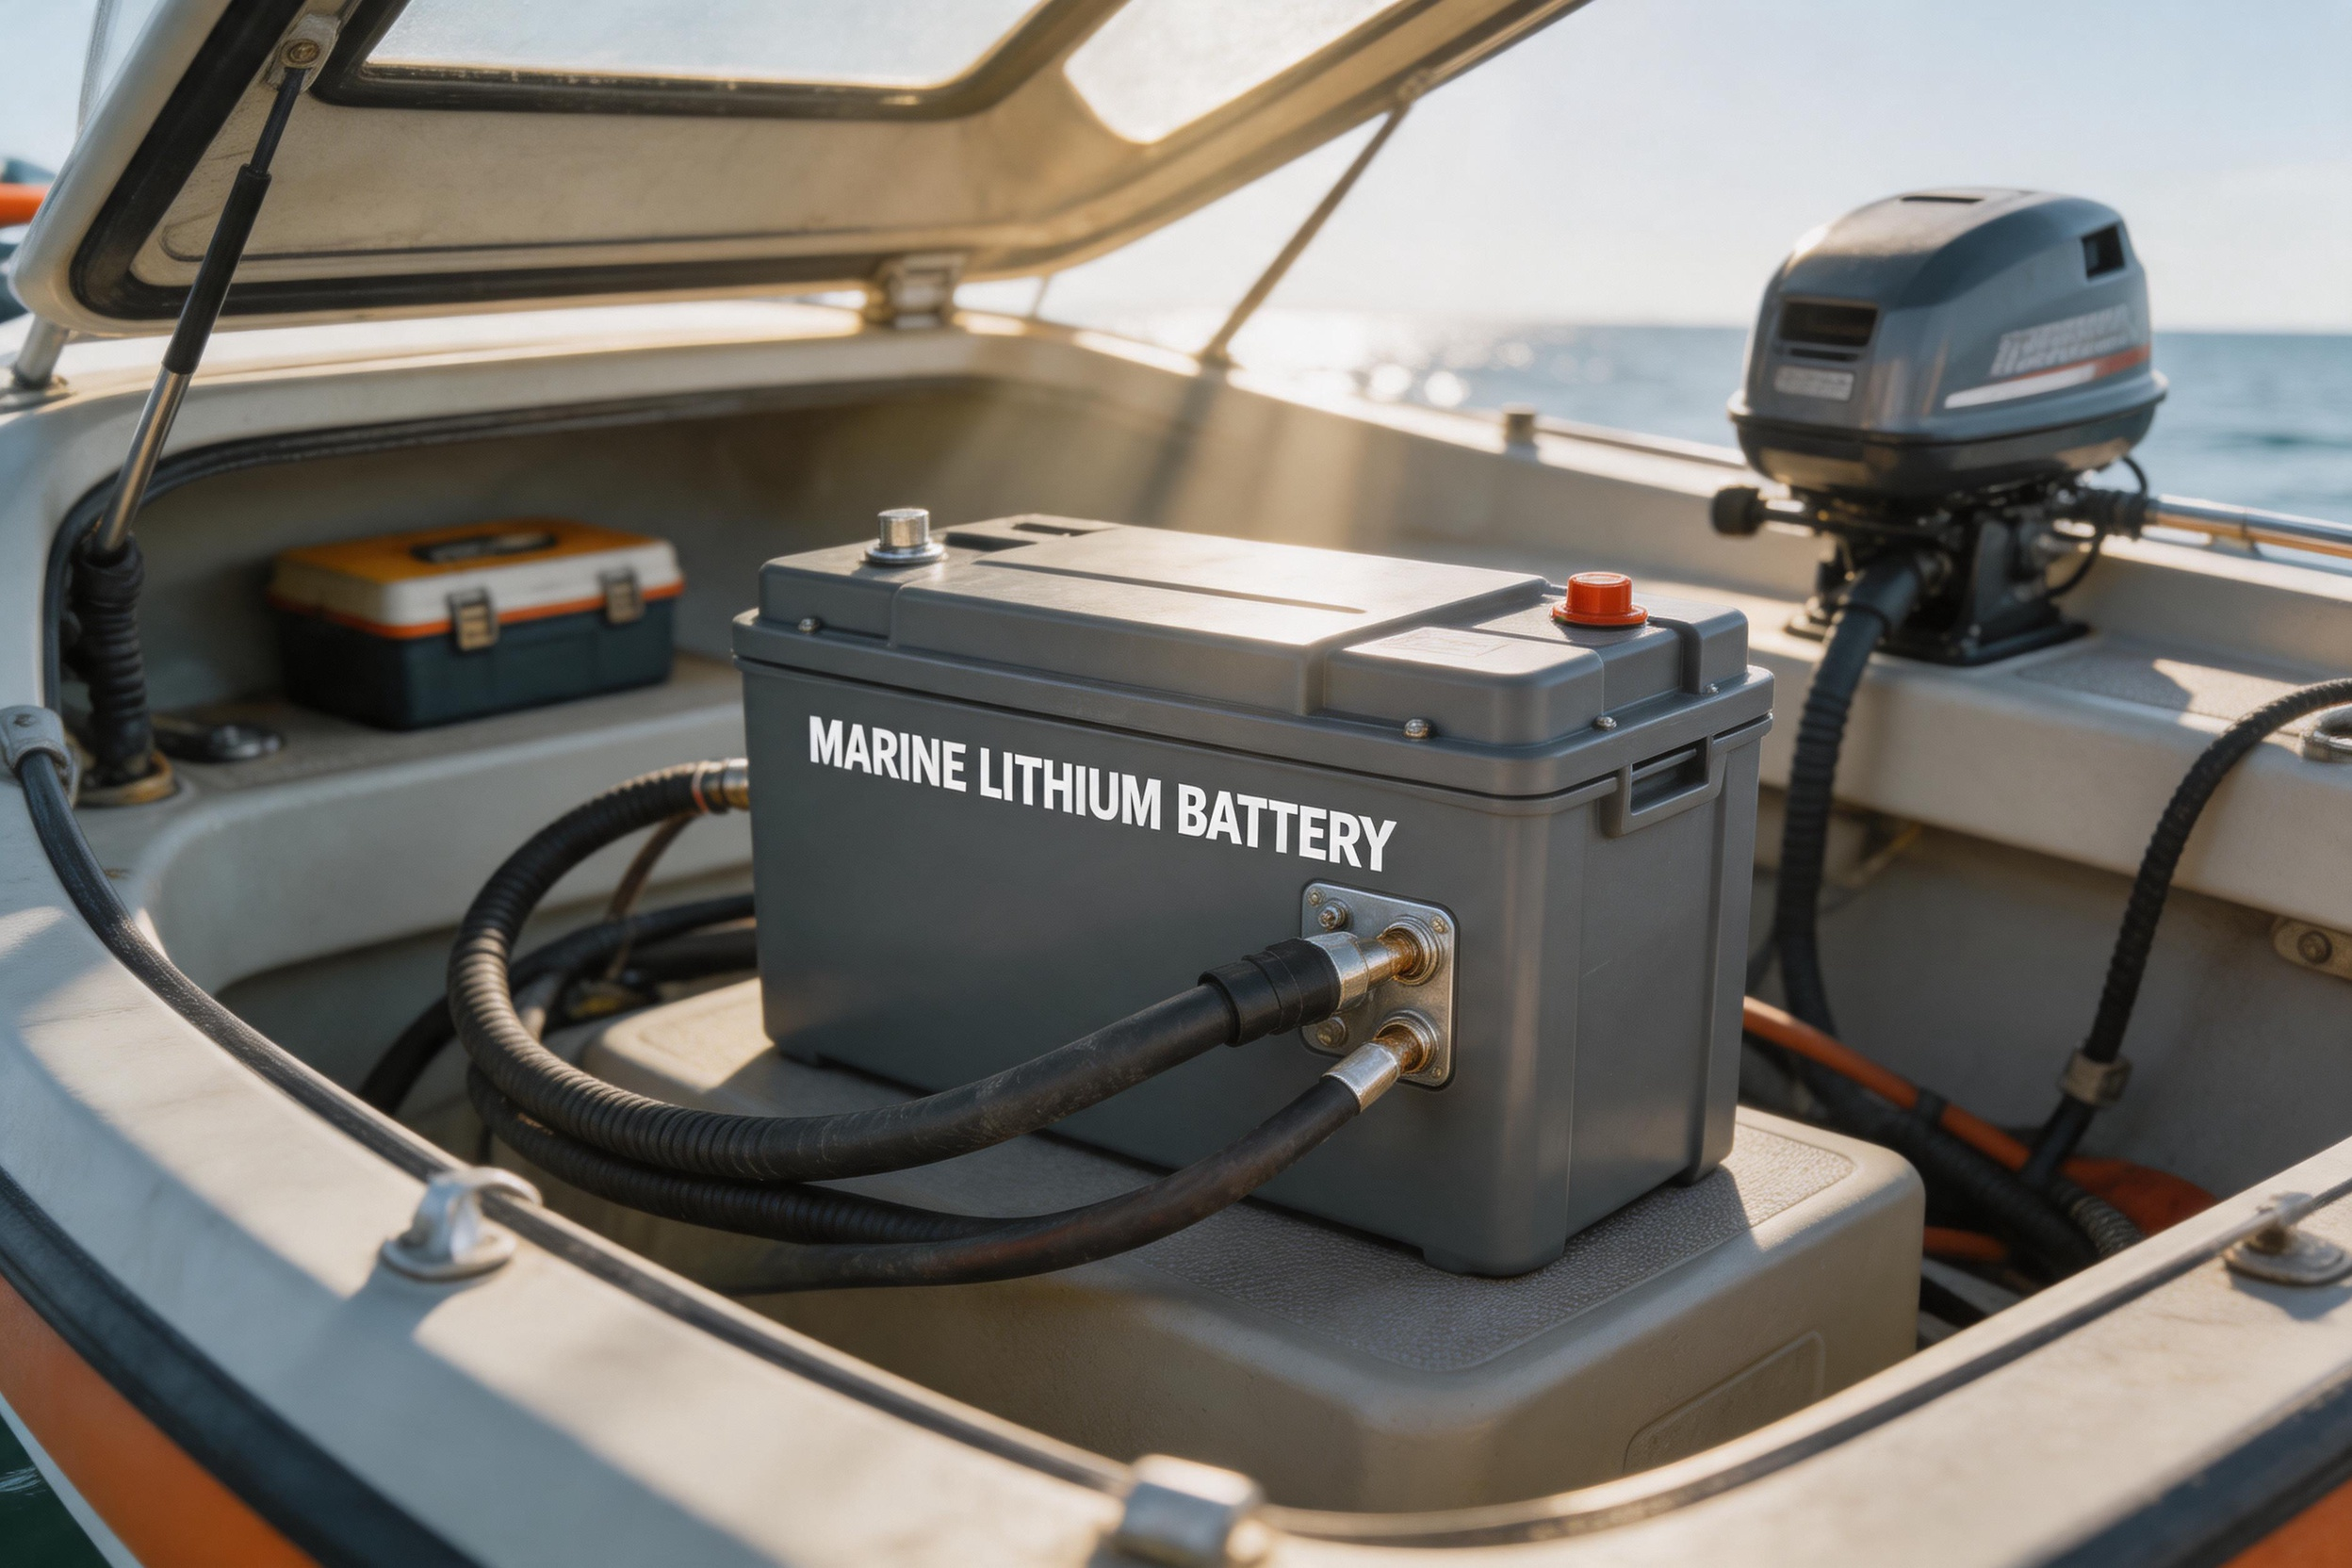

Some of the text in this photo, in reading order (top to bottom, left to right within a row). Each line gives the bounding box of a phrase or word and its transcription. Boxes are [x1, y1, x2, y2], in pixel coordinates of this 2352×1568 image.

[808, 715, 1397, 873] MARINE LITHIUM BATTERY
